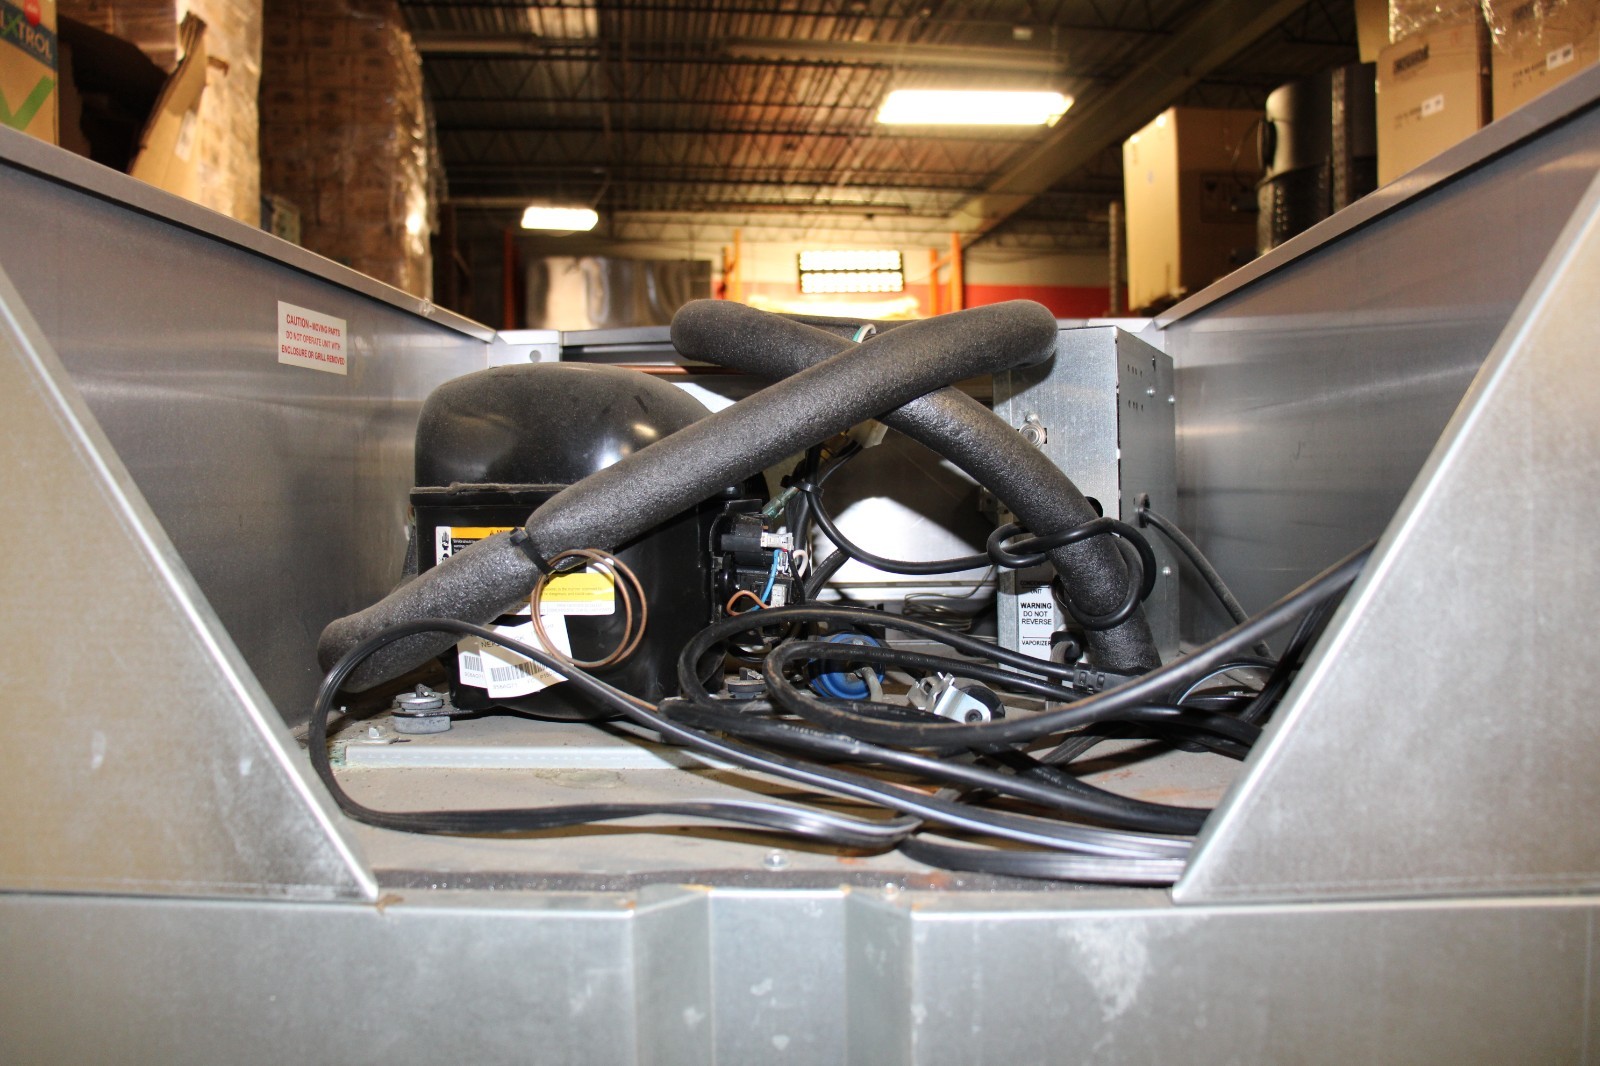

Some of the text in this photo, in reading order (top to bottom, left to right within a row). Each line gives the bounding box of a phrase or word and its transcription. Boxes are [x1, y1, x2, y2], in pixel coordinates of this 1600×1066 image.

[286, 330, 340, 350] DO NOT OPERATE UNIT WITH
[328, 326, 340, 336] PARTS
[281, 344, 345, 366] ENCLOSURE OR GRILL REMOVED
